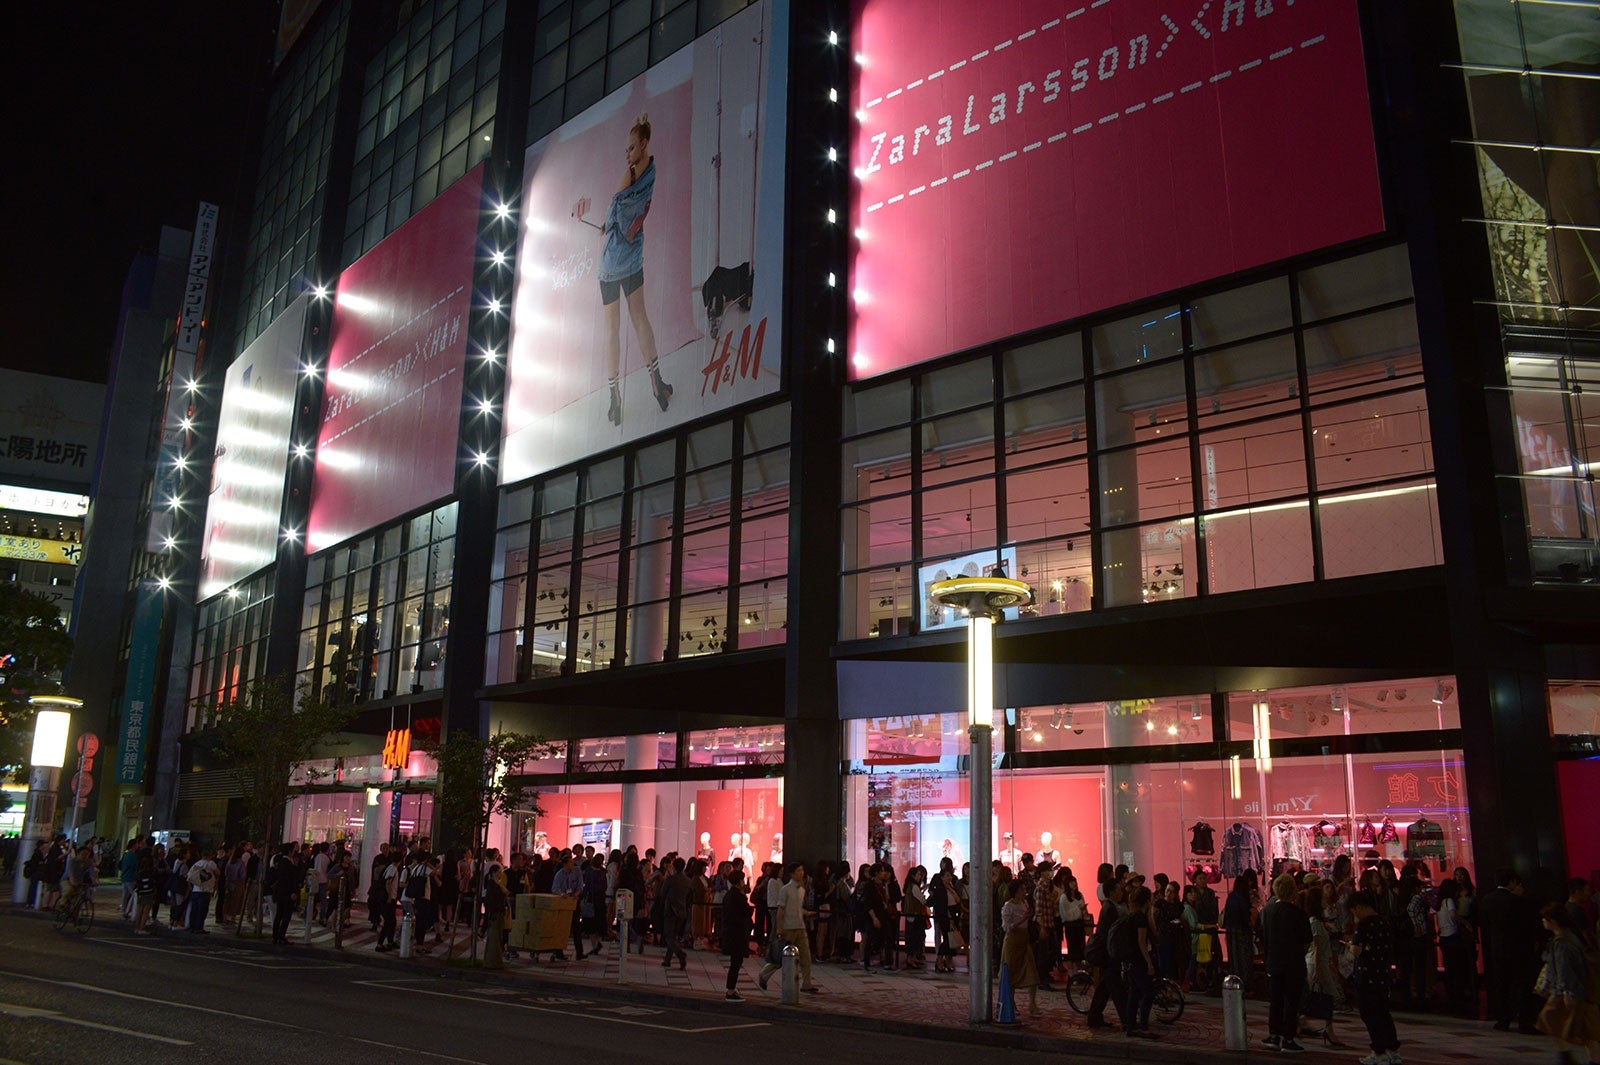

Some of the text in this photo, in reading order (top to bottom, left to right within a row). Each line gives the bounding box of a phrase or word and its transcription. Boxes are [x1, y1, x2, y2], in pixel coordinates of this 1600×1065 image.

[866, 0, 1295, 176] ZaraLarsson><H
[323, 314, 462, 423] ZaraLsson><H&M
[701, 317, 768, 397] H&M
[0, 535, 41, 549] 室あり
[122, 700, 144, 780] 東京都民銀行
[382, 728, 411, 770] H&M
